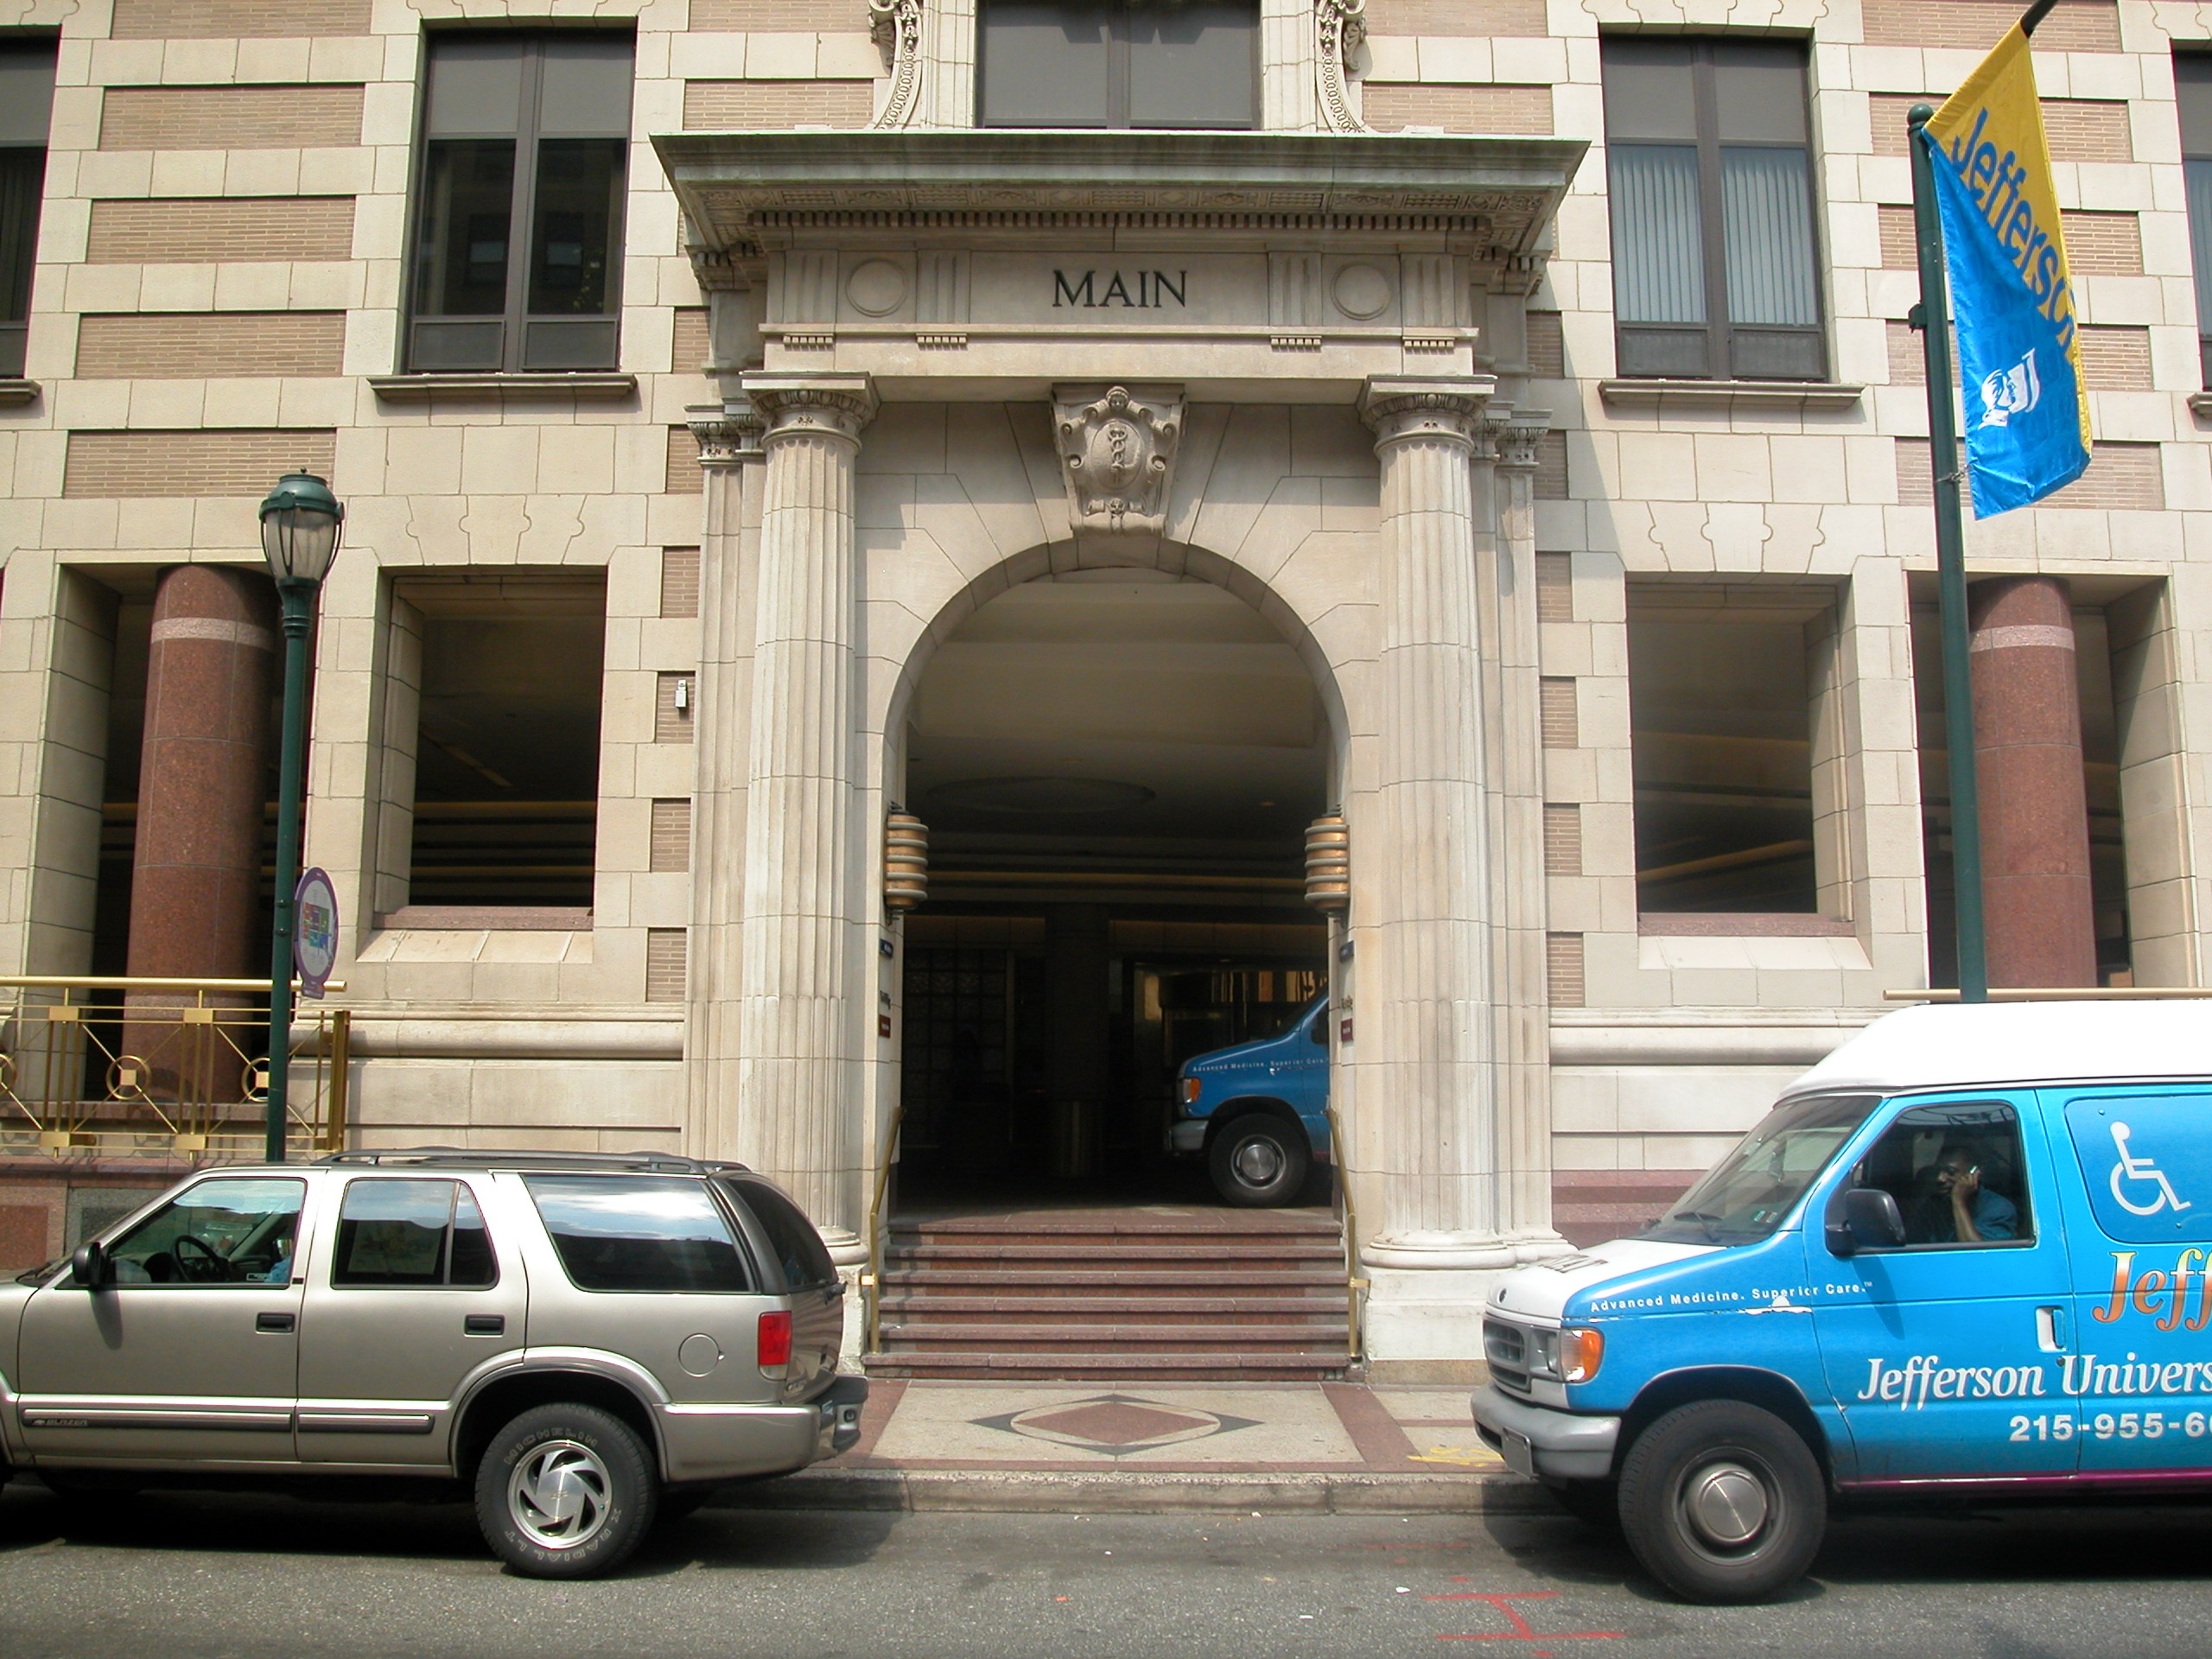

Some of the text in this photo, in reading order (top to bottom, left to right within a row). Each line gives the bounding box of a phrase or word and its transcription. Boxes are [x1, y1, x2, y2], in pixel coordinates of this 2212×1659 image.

[1052, 270, 1187, 308] MAIN
[1591, 1295, 1664, 1313] Advanced
[1670, 1290, 1745, 1306] Medicine.
[1751, 1285, 1819, 1300] Superior
[1858, 1355, 2046, 1411] Jefferson
[2009, 1411, 2212, 1441] 215-955-6
[504, 1427, 598, 1465] MICHELIN
